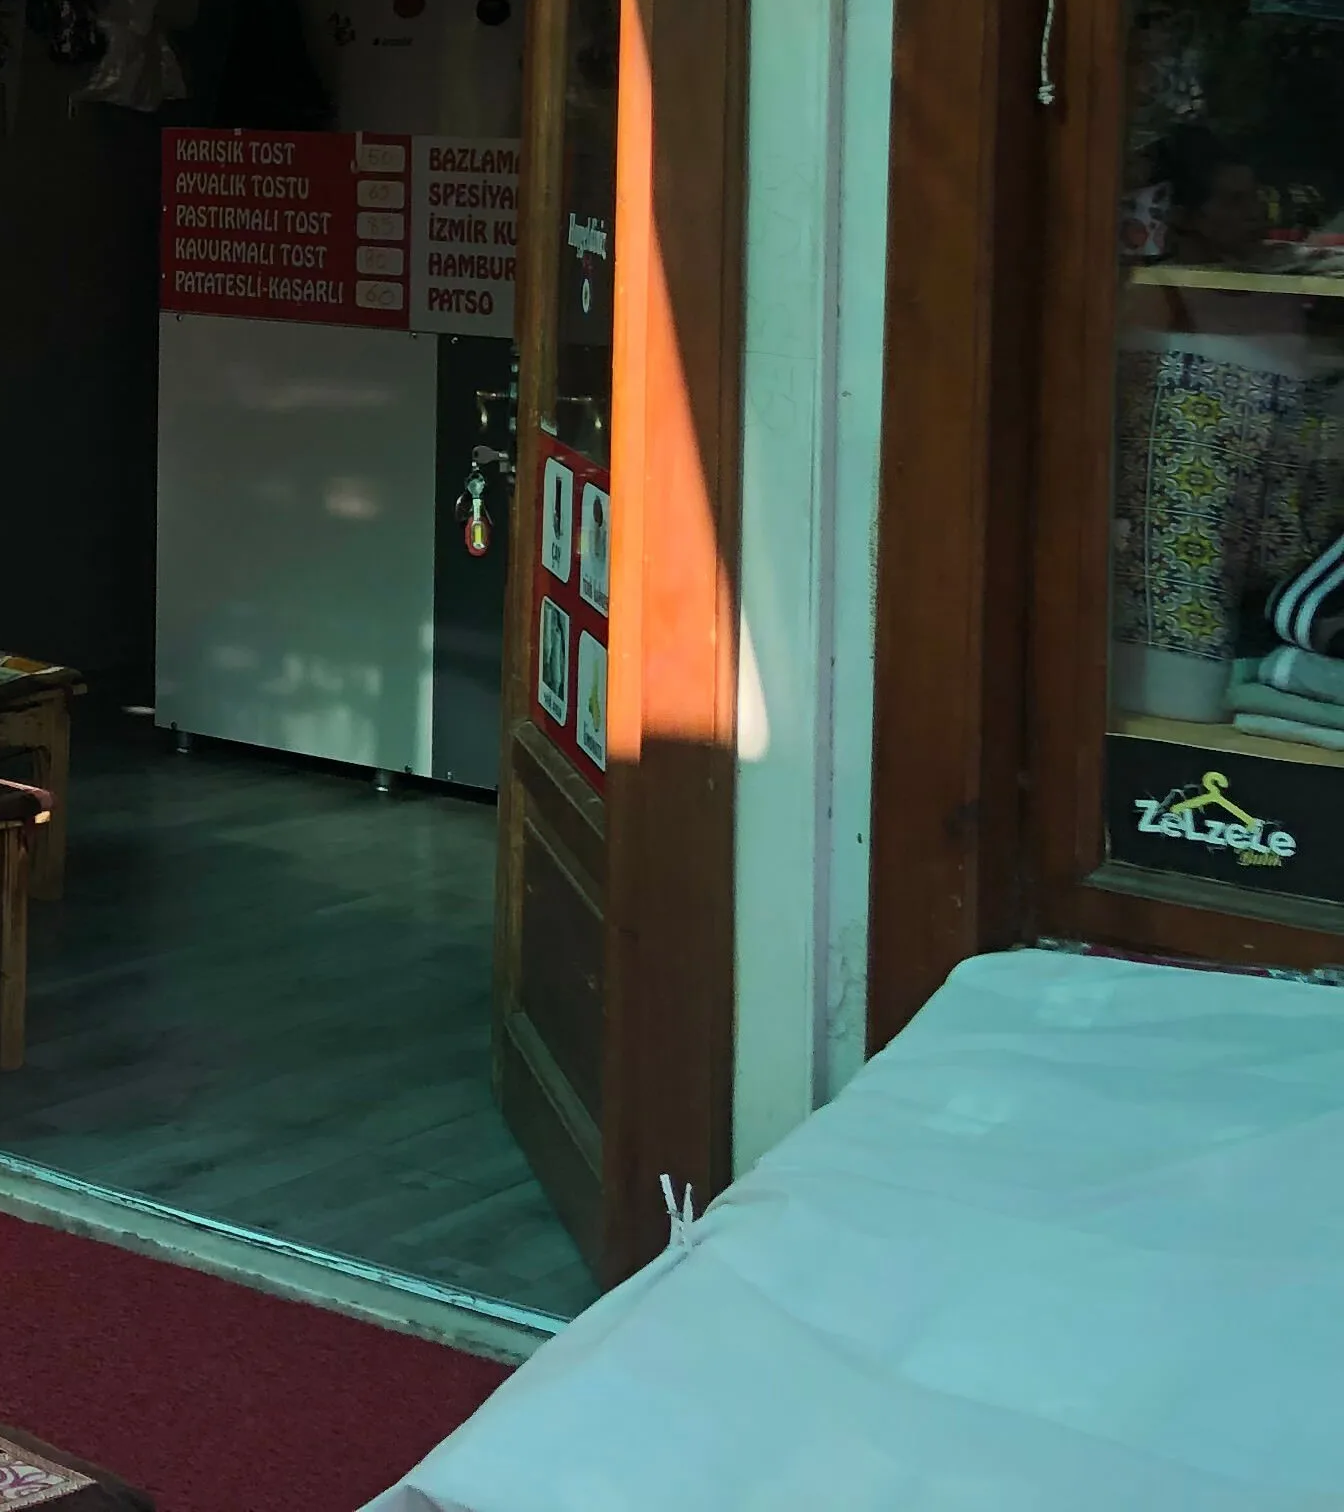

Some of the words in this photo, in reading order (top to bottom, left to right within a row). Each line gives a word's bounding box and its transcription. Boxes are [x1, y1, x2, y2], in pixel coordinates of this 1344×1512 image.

[176, 139, 244, 168] KARIŞIK
[250, 142, 296, 166] TOST
[176, 172, 246, 197] AYVALIK
[252, 175, 310, 200] TOSTU
[429, 180, 519, 209] SPESİYA
[176, 204, 279, 233] PASTIRMALI
[284, 210, 333, 235] TOST
[429, 212, 488, 244] İZMİR
[175, 237, 275, 265] KAVURMALI
[280, 243, 328, 268] TOST
[428, 287, 494, 315] PATSO
